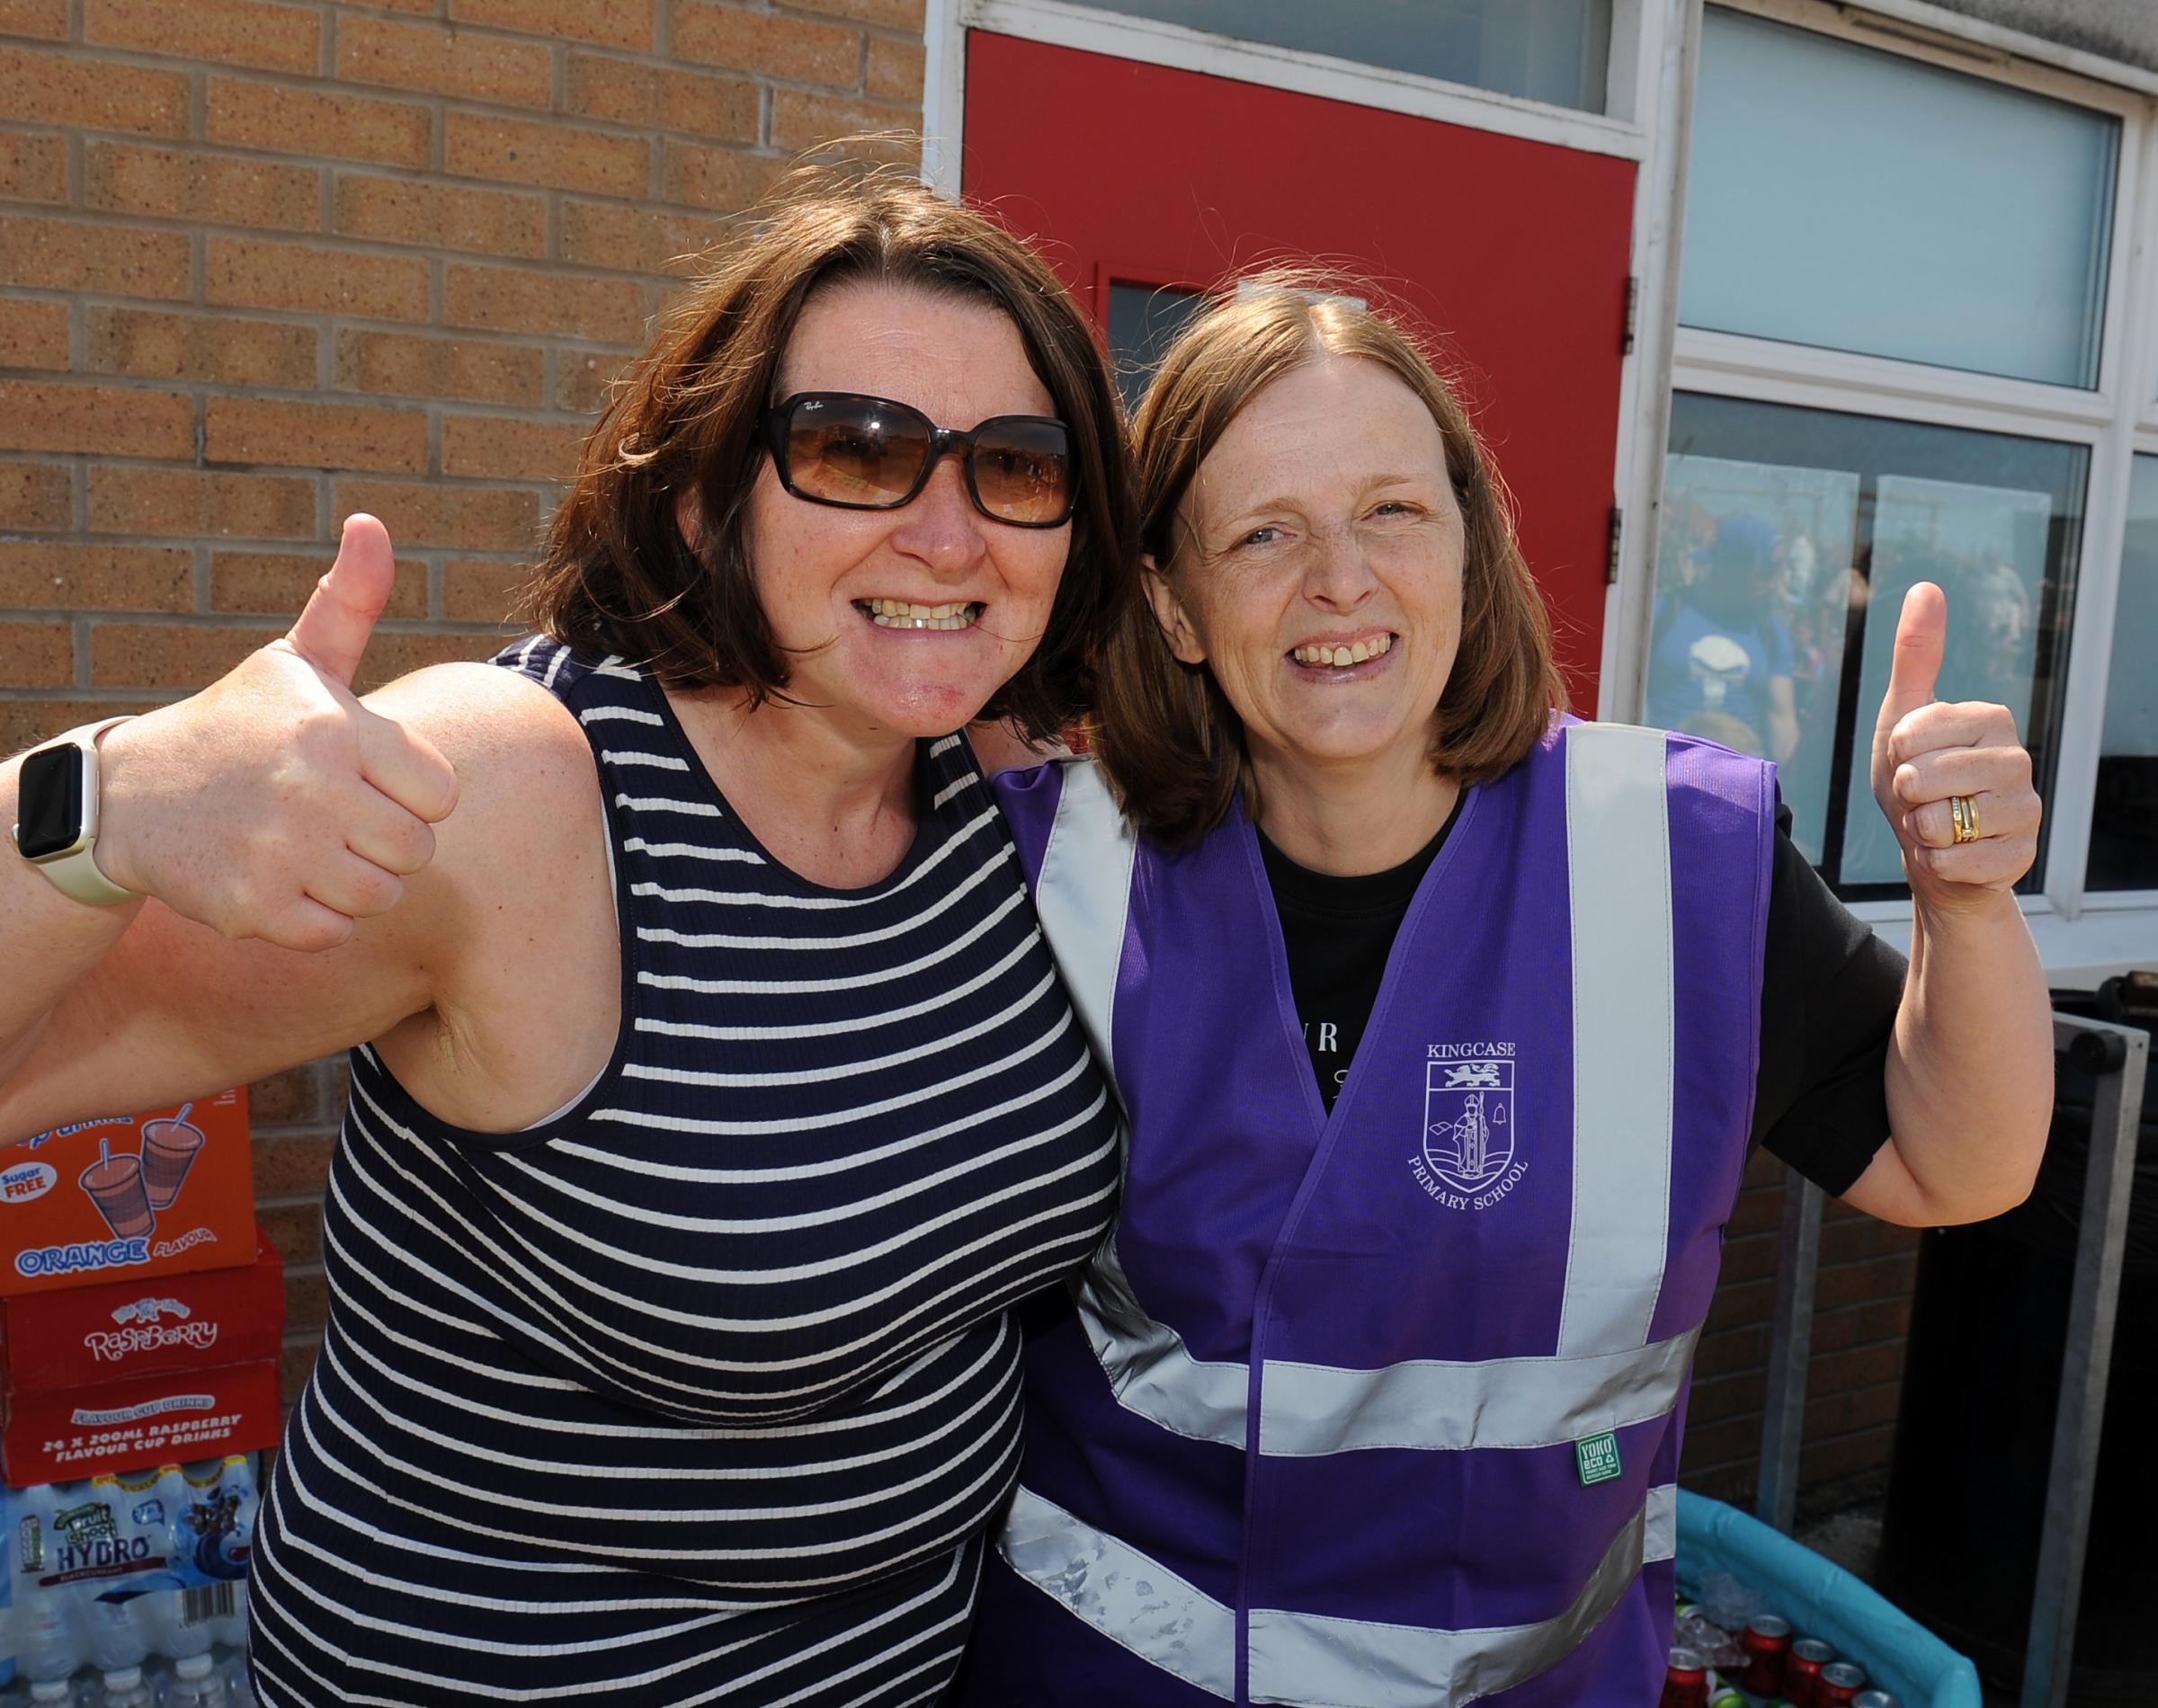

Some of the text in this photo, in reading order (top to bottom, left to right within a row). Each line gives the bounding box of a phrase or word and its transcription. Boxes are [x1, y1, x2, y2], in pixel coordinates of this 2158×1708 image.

[1427, 1042, 1516, 1058] KINGCASE
[2, 1167, 41, 1185] Sugar
[4, 1176, 47, 1198] FREE
[1408, 1155, 1529, 1210] PRIMARY SCHOOL
[15, 1238, 150, 1277] ORANGE
[149, 1414, 243, 1437] RASPBERRY
[56, 1428, 232, 1463] FLAVOUR CUP DRINKS
[1582, 1438, 1612, 1460] YOKO
[58, 1536, 149, 1572] HYDRO
